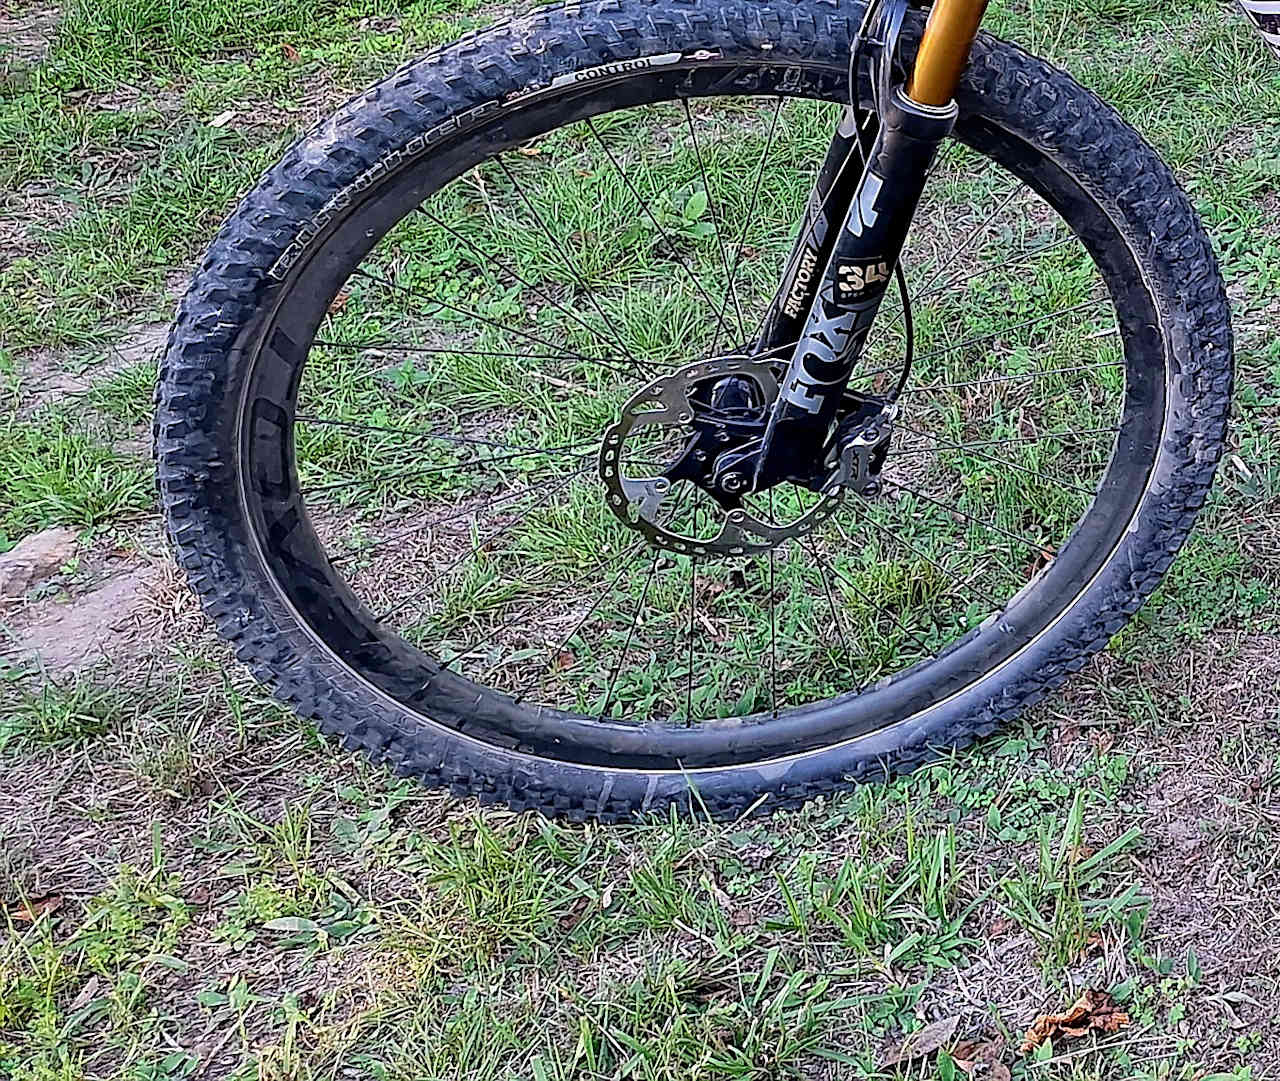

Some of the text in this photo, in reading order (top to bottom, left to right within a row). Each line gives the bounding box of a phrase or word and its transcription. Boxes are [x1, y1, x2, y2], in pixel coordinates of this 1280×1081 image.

[784, 248, 818, 319] FACTORY
[839, 262, 889, 291] 34
[782, 280, 856, 415] FOX
